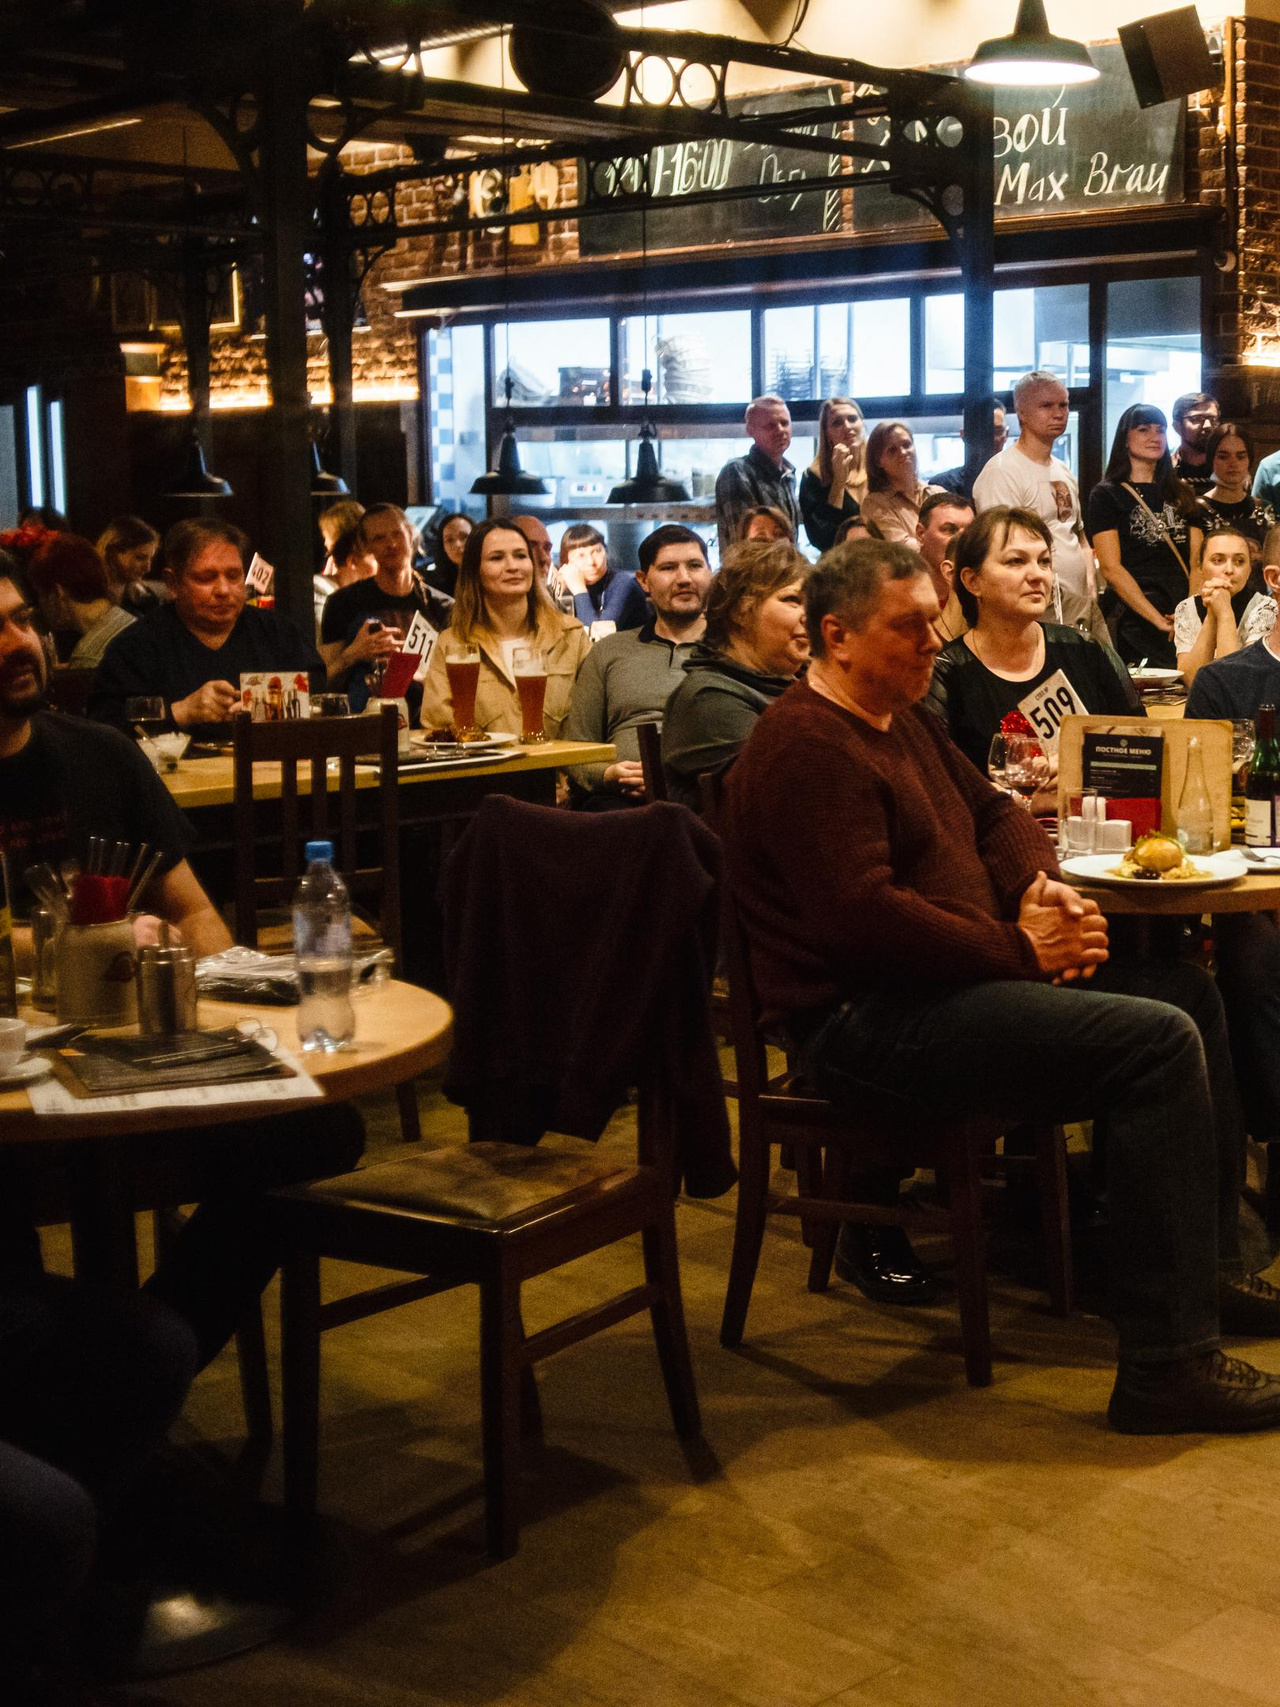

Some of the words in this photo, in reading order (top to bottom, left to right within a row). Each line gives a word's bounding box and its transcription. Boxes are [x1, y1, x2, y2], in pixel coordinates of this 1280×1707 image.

[994, 162, 1069, 206] Max
[1084, 152, 1170, 196] Brau
[409, 623, 433, 663] 511
[1029, 686, 1077, 739] 509
[1095, 746, 1128, 754] ПОСТНОЕ
